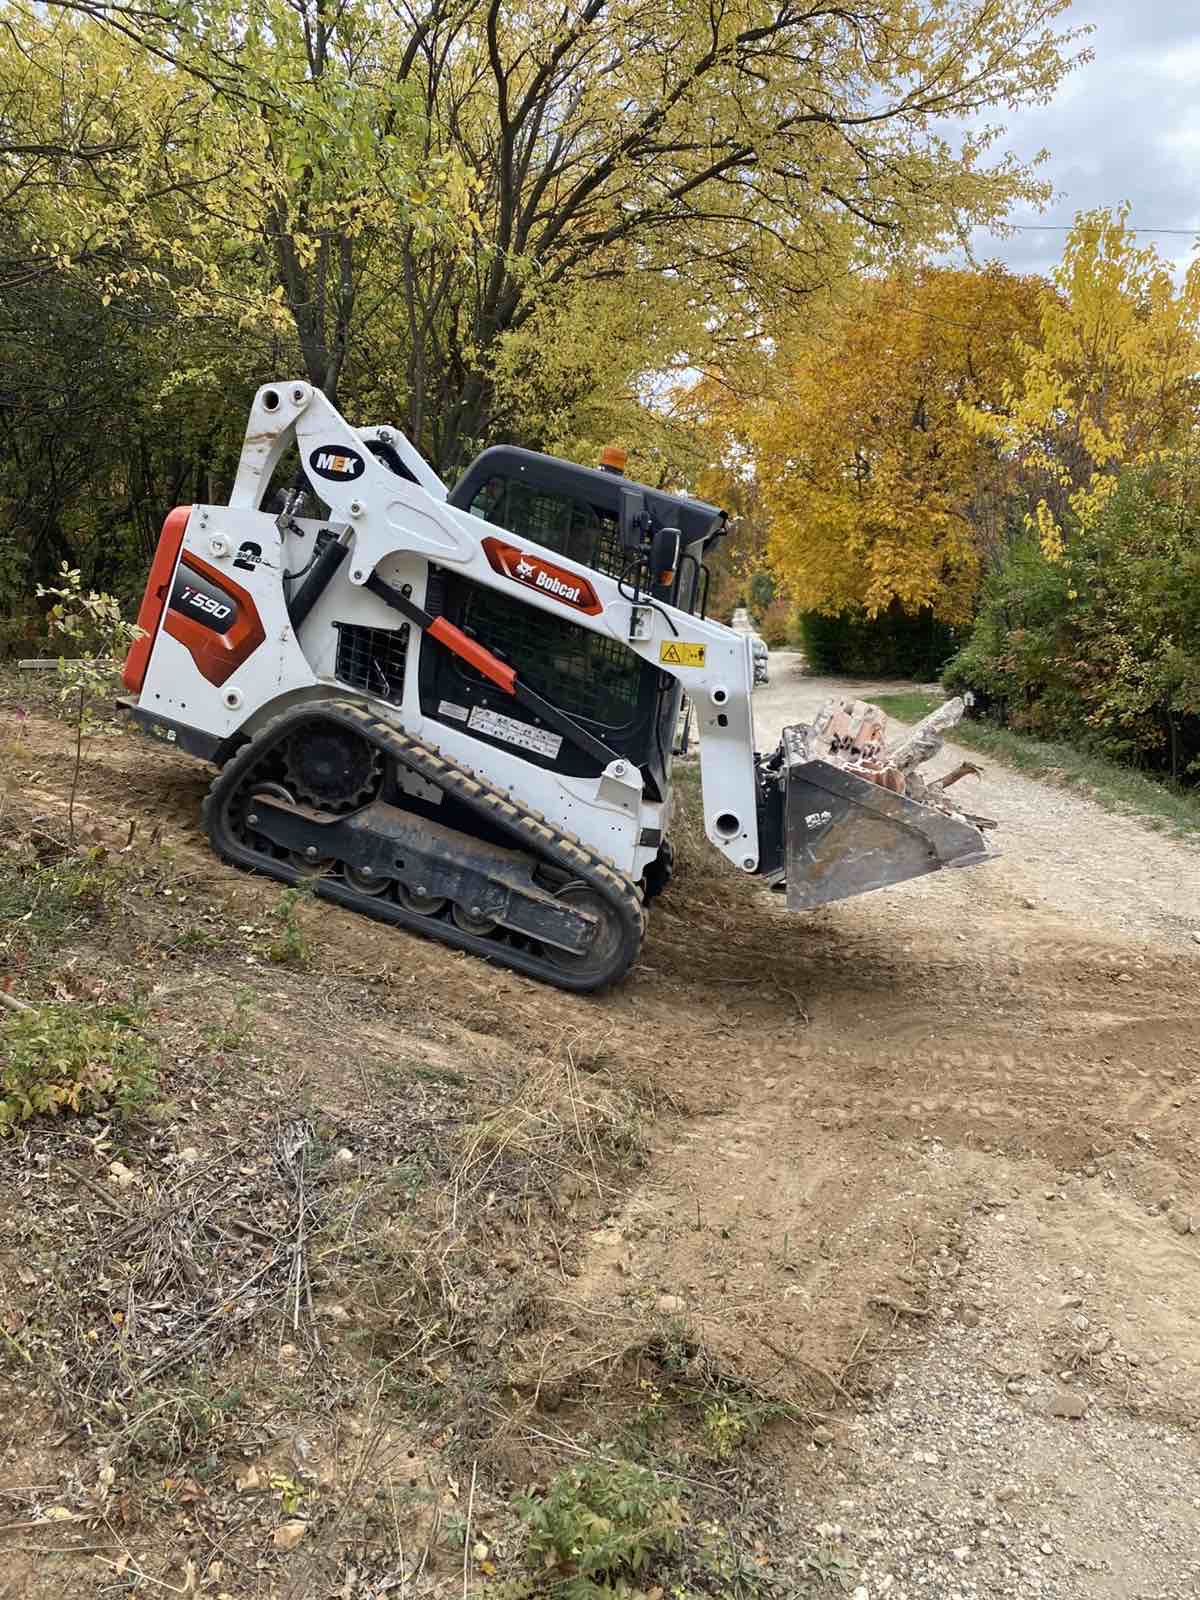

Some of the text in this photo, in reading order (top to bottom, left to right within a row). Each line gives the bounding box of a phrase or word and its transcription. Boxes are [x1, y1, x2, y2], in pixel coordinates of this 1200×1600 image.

[316, 452, 359, 474] MEK
[233, 541, 262, 571] 2
[536, 570, 580, 602] Bobcat
